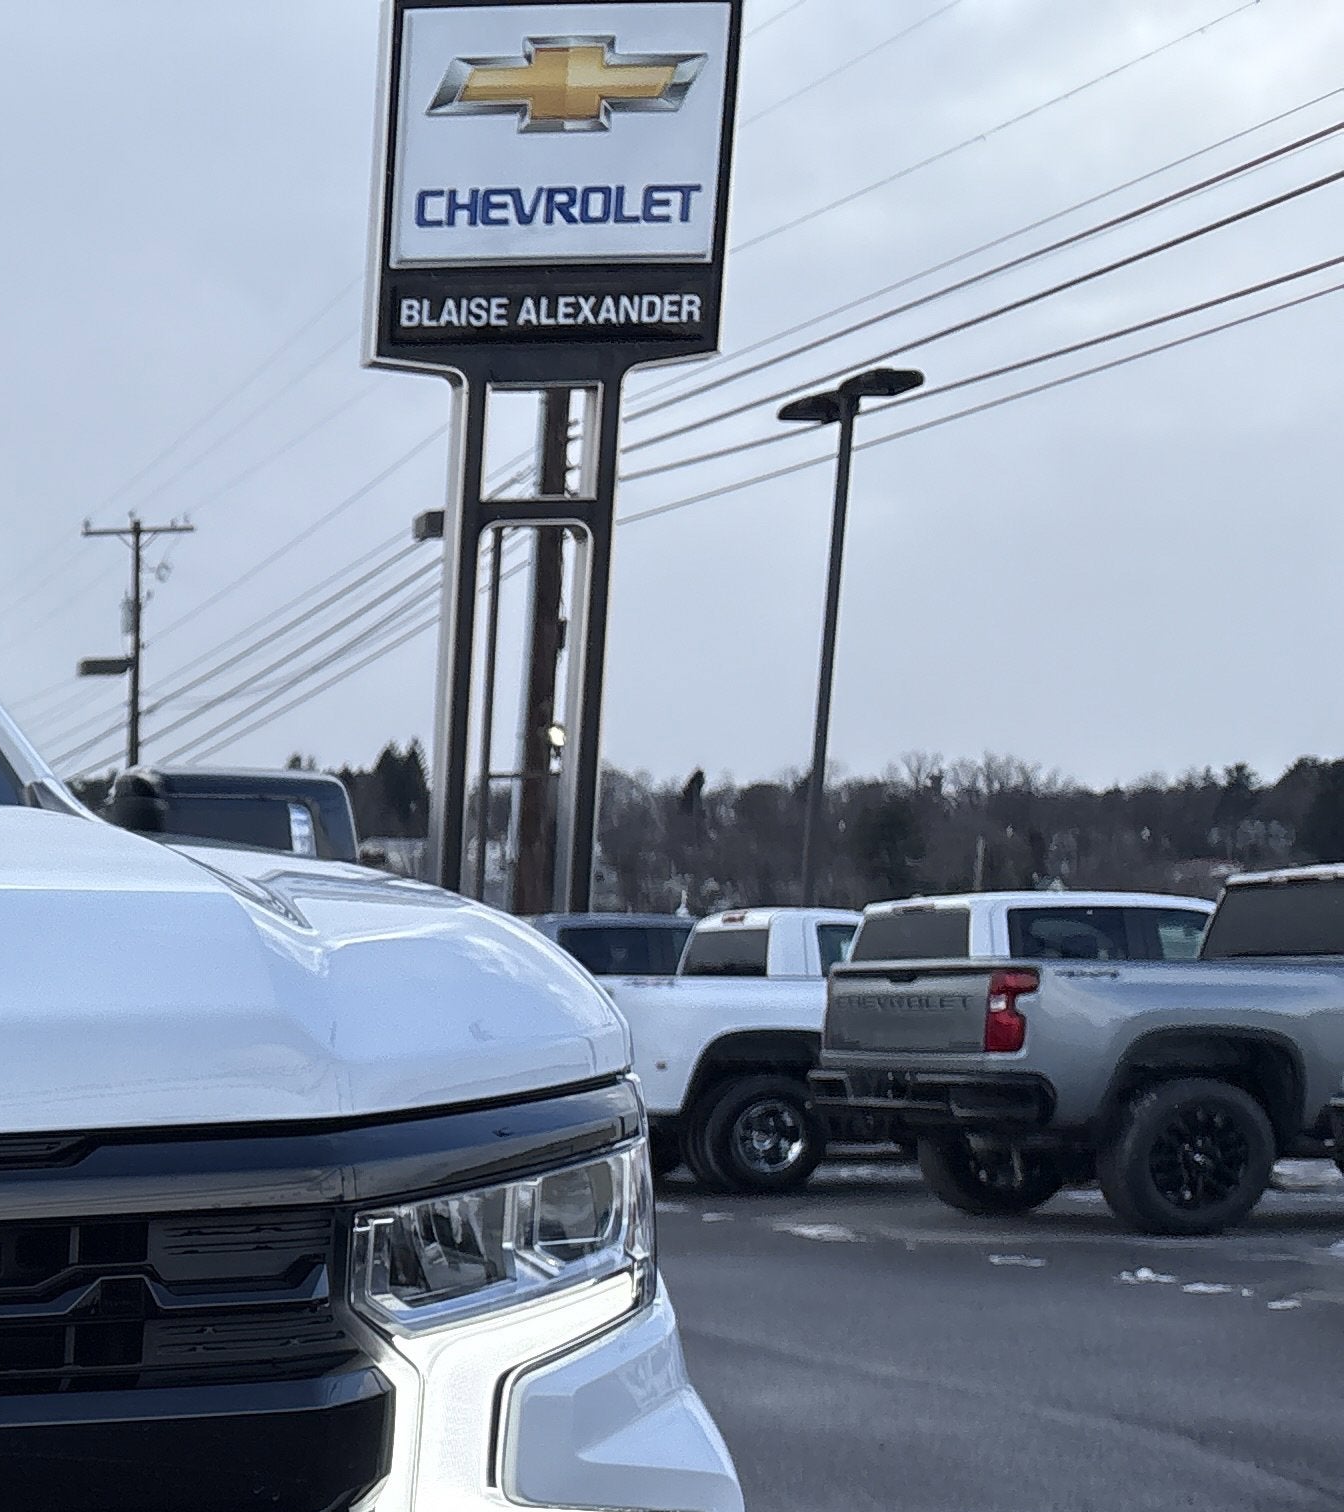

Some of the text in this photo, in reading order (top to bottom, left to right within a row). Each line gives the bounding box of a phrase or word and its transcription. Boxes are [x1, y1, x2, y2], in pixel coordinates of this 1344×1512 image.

[416, 184, 702, 227] CHEVROLET
[400, 294, 701, 327] BLAISE ALEXANDER
